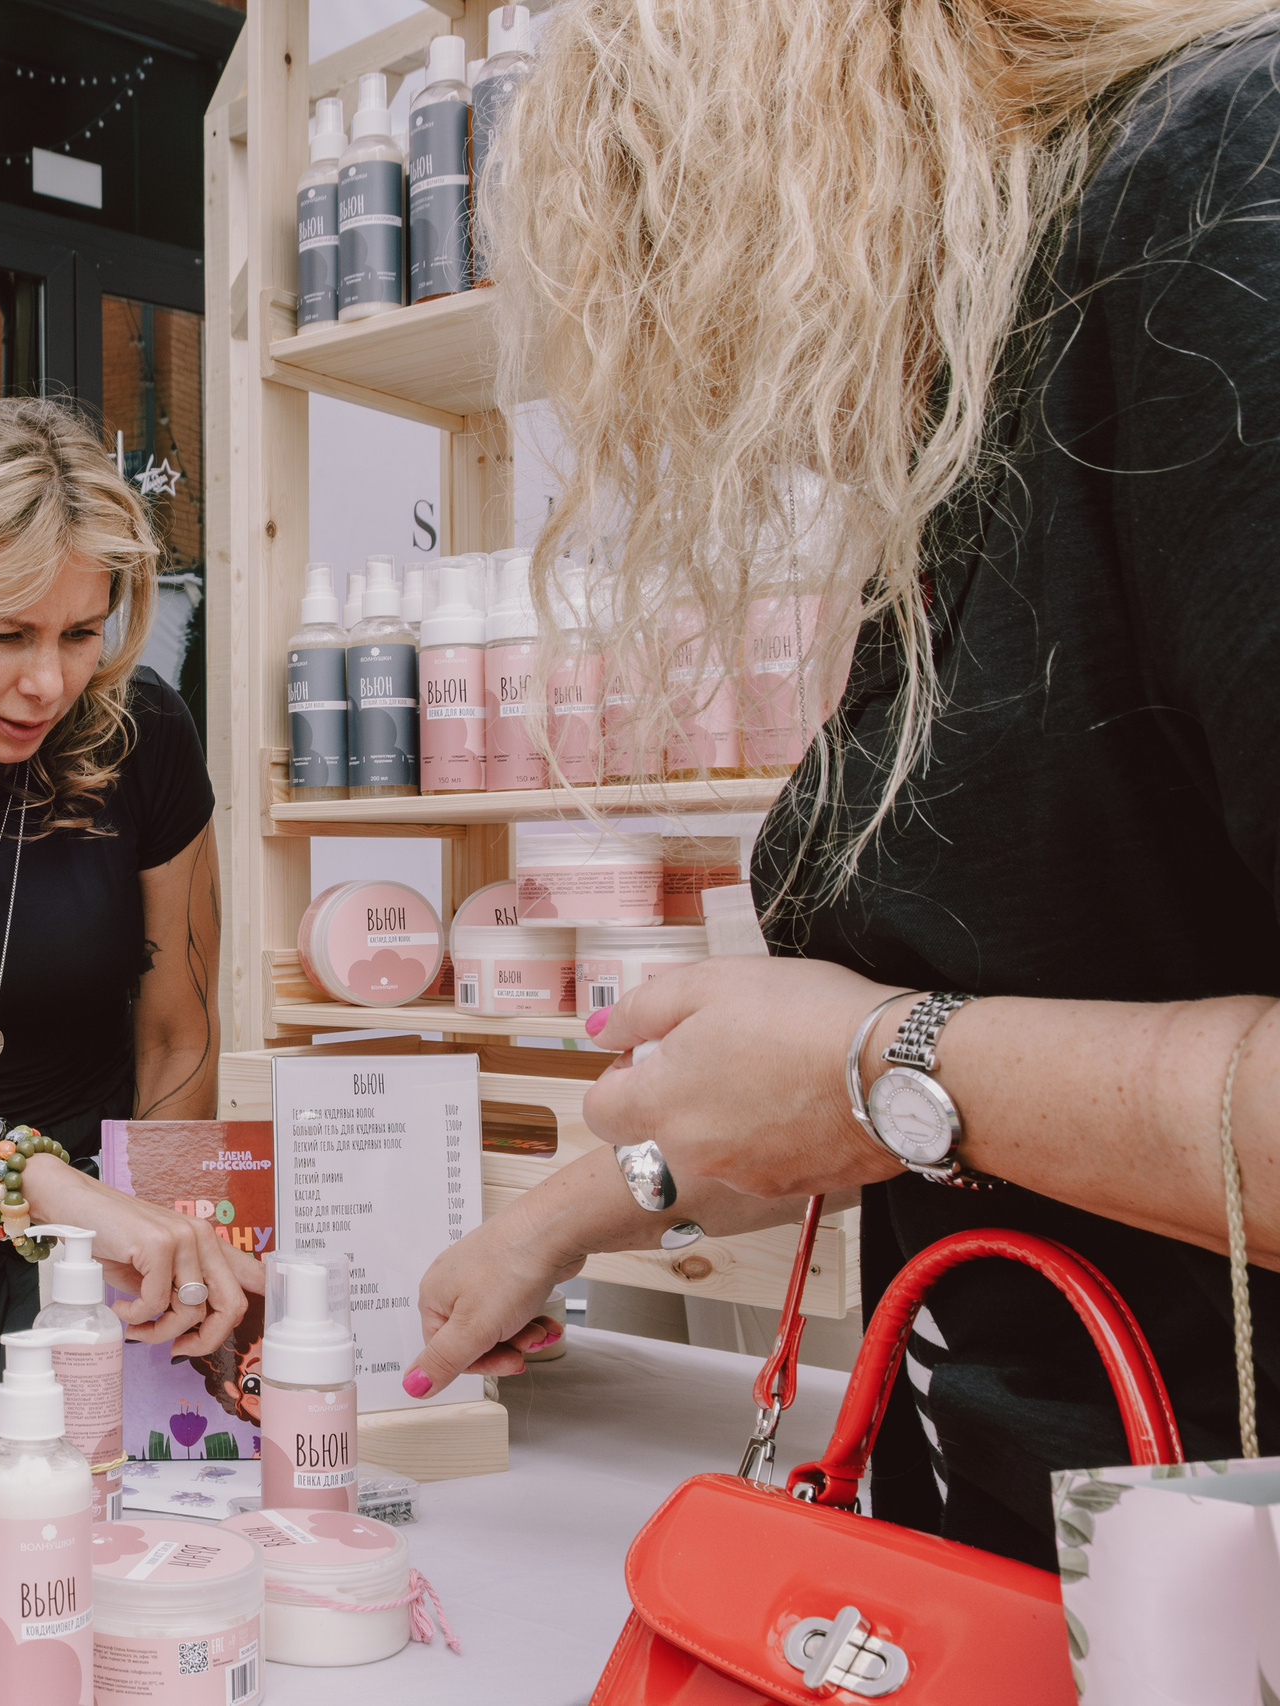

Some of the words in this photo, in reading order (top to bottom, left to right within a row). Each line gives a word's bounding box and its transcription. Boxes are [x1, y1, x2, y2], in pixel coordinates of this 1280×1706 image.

[339, 194, 365, 222] ВЬЮН
[298, 215, 324, 242] ВЬЮН
[360, 676, 393, 698] ВЬЮН
[427, 678, 467, 705] ВЬЮН
[428, 709, 444, 718] ПЕНКА
[444, 708, 458, 718] ДЛЯ
[459, 708, 476, 717] ВОЛОС
[502, 706, 520, 716] ПЕНКА
[366, 906, 406, 931] ВЬЮН
[498, 970, 522, 984] ВЬЮН
[353, 1073, 385, 1095] ВЬЮН
[324, 1108, 355, 1120] КУДРЯВЫХ
[356, 1107, 375, 1119] ВОЛОС
[292, 1123, 323, 1136] БОЛЬШОЙ
[324, 1124, 339, 1136] ГЕЛЬ
[340, 1123, 355, 1136] ДЛЯ
[356, 1123, 386, 1135] КУДРЯВЫХ
[387, 1122, 406, 1134] ВОЛОС
[293, 1140, 319, 1153] ЛЕГКИЙ
[320, 1140, 335, 1152] ГЕЛЬ
[336, 1140, 351, 1152] ДЛЯ
[352, 1139, 382, 1151] КУДРЯВЫХ
[383, 1138, 402, 1149] ВОЛОС
[218, 1150, 252, 1161] ЕЛЕНА
[202, 1159, 272, 1171] ГРОССКОПФ
[294, 1157, 316, 1169] ЛИВИН
[294, 1171, 320, 1185] ЛЕГКИЙ
[321, 1173, 344, 1184] ЛИВИН
[294, 1189, 322, 1201] КАСТАРД
[174, 1199, 235, 1225] ПРО
[294, 1205, 314, 1218] НАБОР
[314, 1205, 330, 1218] ДЛЯ
[330, 1201, 373, 1216] ПУТЕШЕСТВИЙ
[295, 1221, 315, 1234] ПЕНКА
[316, 1221, 331, 1234] ДЛЯ
[332, 1220, 352, 1232] ВОЛОС
[295, 1238, 326, 1250] ШАМПУНЬ
[360, 1283, 379, 1295] ВОЛОС
[375, 1298, 390, 1310] ДЛЯ
[391, 1296, 410, 1309] ВОЛОС
[371, 1361, 401, 1374] ШАМПУНЬ
[308, 1402, 349, 1412] ВОЛНУШКИ
[296, 1431, 349, 1468] ВЬЮН
[297, 1474, 322, 1487] ПЕНКА
[322, 1474, 339, 1488] ДЛЯ
[340, 1470, 356, 1485] ВОЛОС
[241, 1525, 297, 1548] ВЬЮН
[20, 1536, 75, 1552] ВОЛНУШКИ
[167, 1544, 222, 1570] ВЬЮН
[21, 1576, 76, 1618] ВЬЮН
[25, 1619, 75, 1637] КОНДИЦИОНЕР
